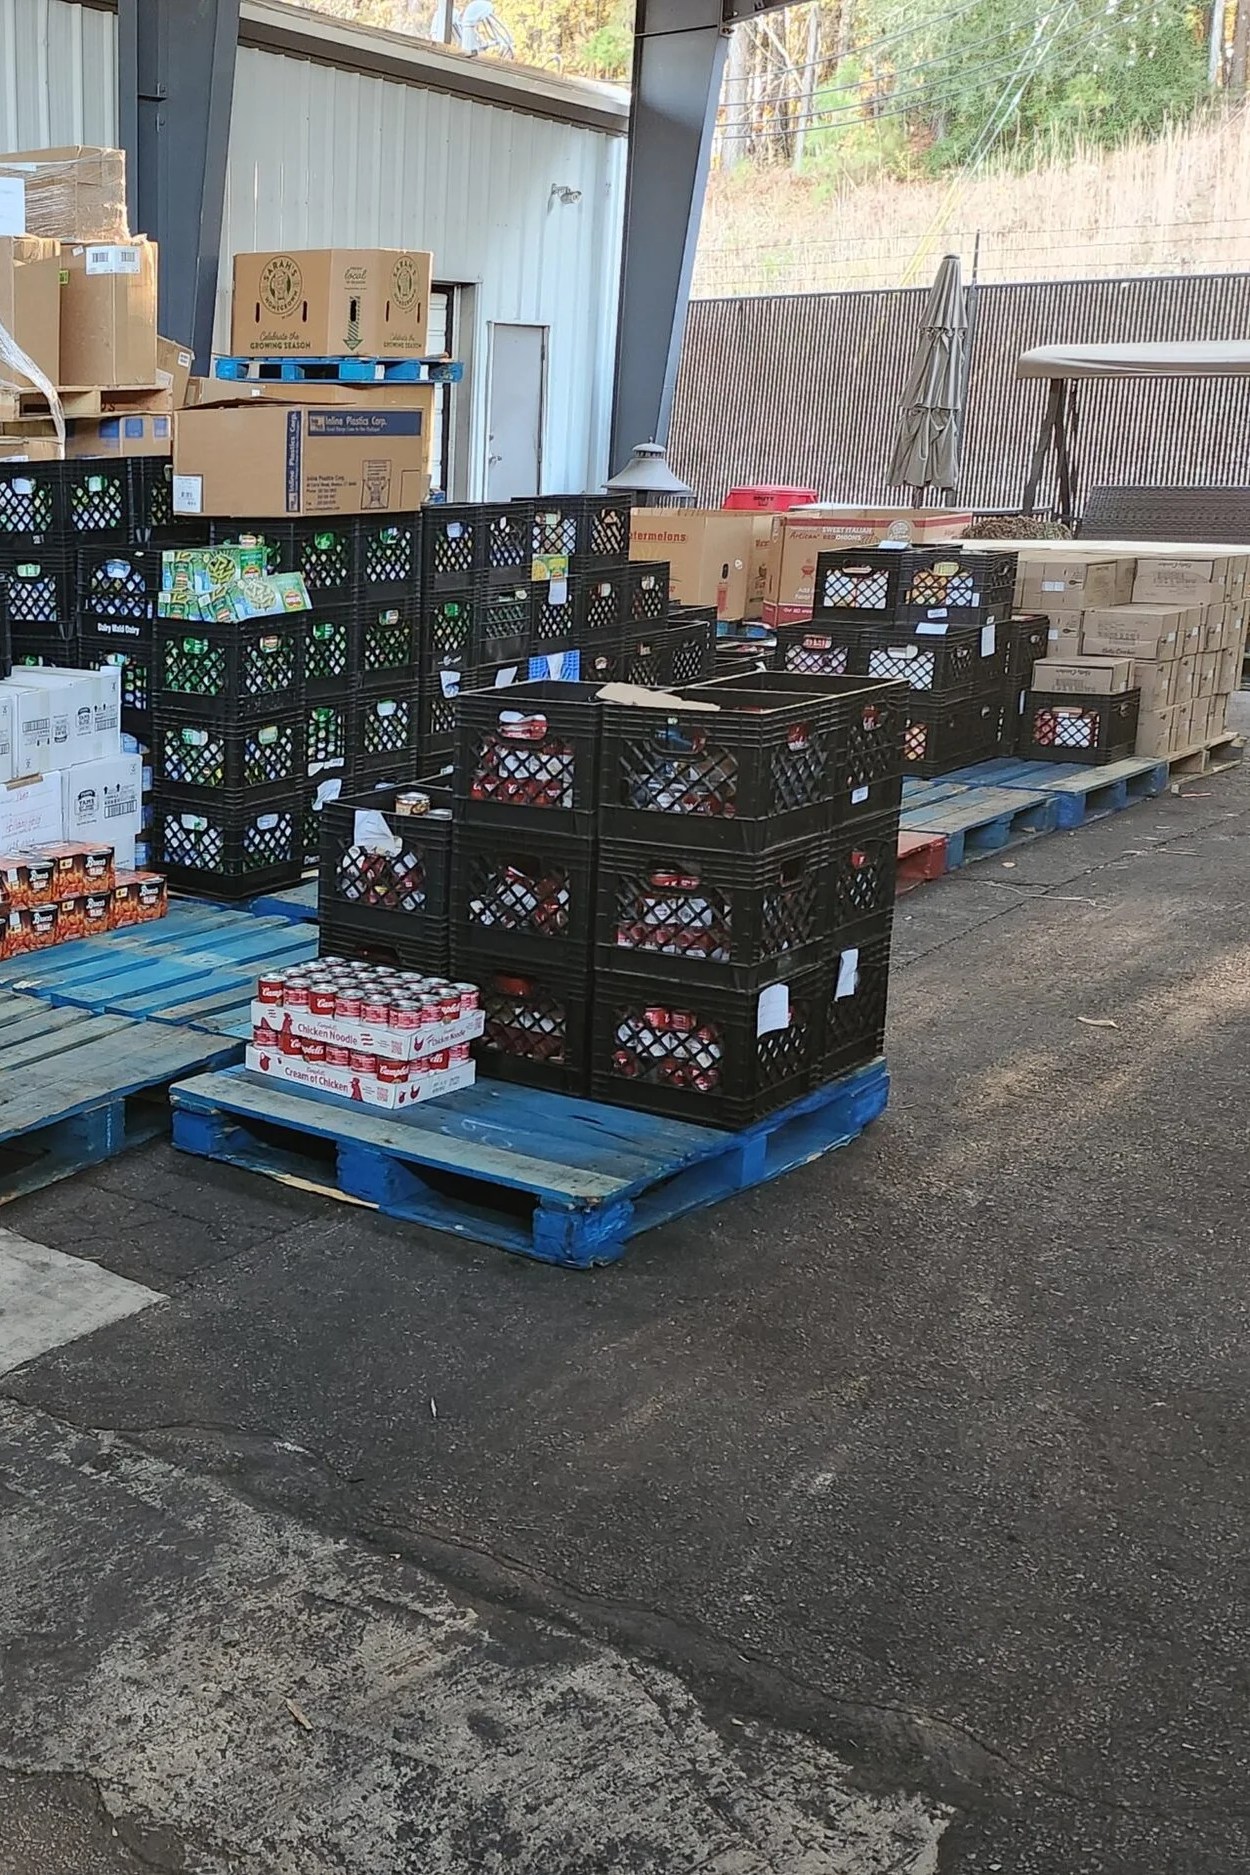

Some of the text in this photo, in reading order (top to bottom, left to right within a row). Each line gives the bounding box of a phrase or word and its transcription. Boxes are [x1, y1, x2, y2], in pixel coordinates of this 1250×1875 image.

[263, 260, 298, 281] SARAH'S
[344, 268, 367, 280] local
[250, 341, 311, 350] GROWING SEASON
[346, 416, 369, 426] Plastics
[371, 416, 388, 428] Corp.
[297, 1023, 358, 1045] Chicken Noodle
[285, 1067, 349, 1093] Cream of Chicken
